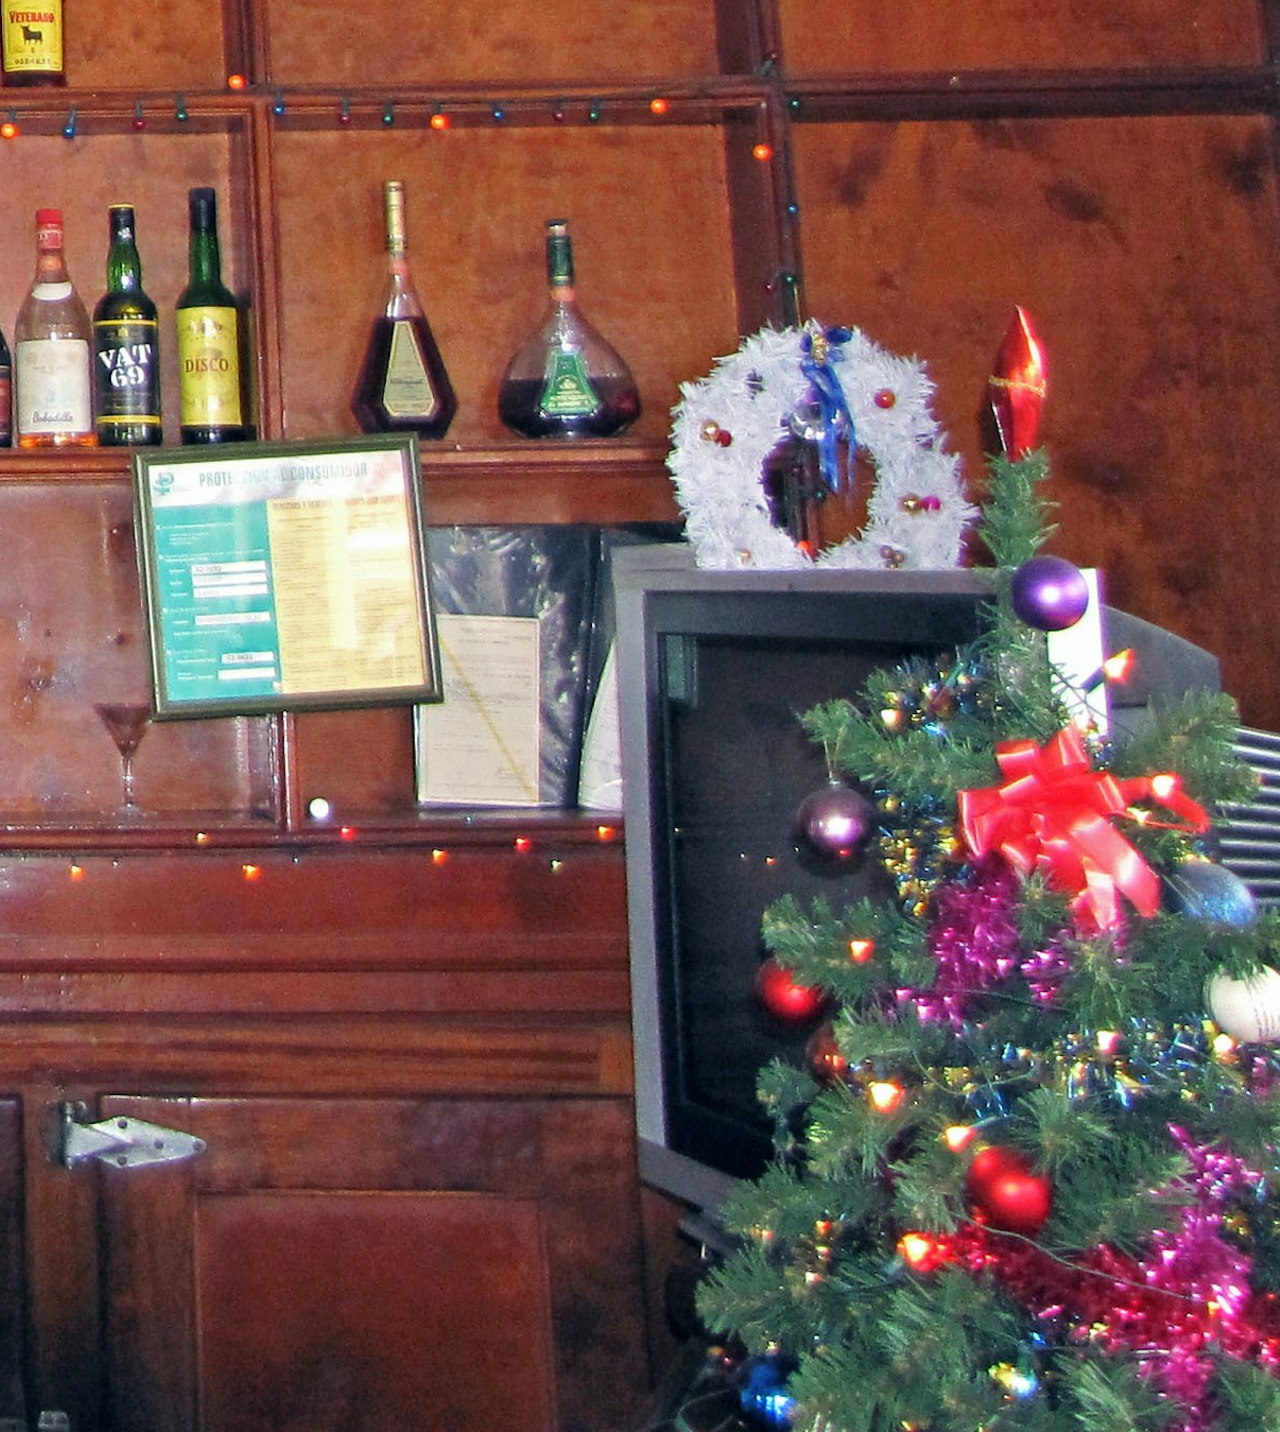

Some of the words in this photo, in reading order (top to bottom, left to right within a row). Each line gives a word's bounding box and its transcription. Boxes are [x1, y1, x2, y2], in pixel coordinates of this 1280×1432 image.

[97, 344, 152, 369] VAT
[185, 358, 229, 373] DISCO
[110, 365, 145, 388] 69
